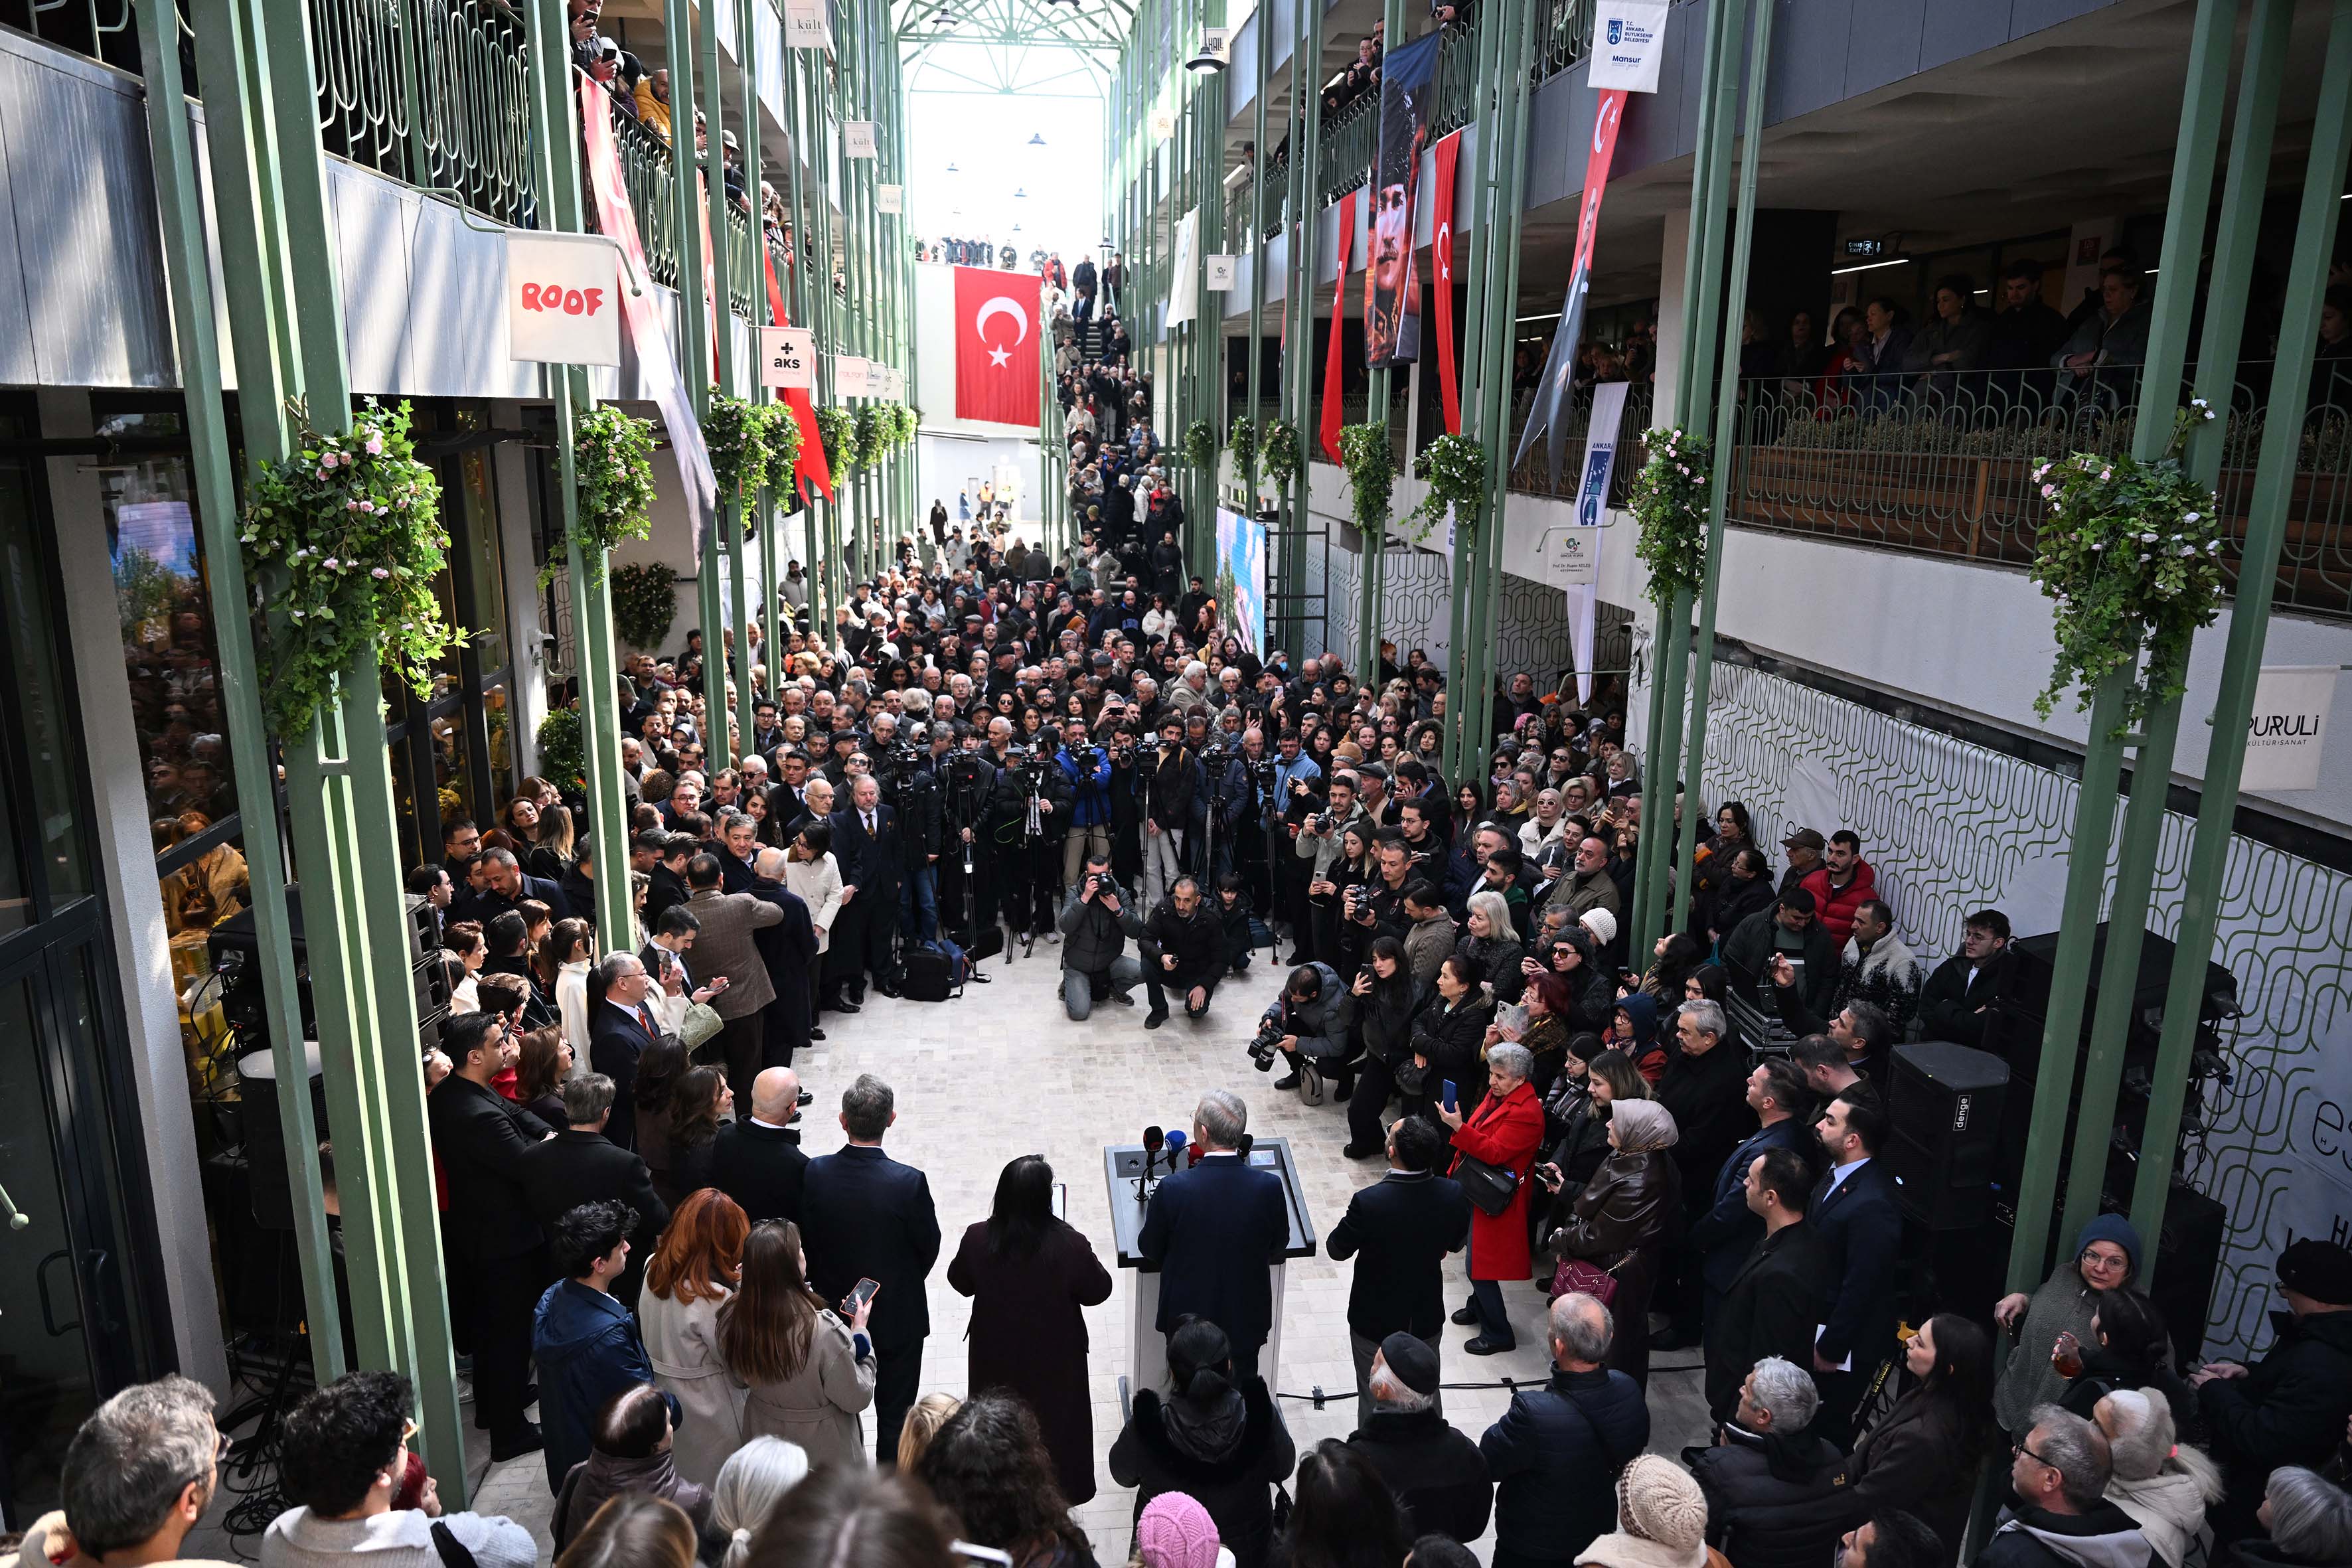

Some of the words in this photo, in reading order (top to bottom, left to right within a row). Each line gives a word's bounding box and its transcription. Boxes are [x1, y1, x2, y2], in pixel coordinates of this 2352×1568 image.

[797, 19, 821, 29] kült
[522, 283, 603, 316] ROOF
[774, 358, 800, 369] aks
[1956, 1098, 1968, 1128] denge
